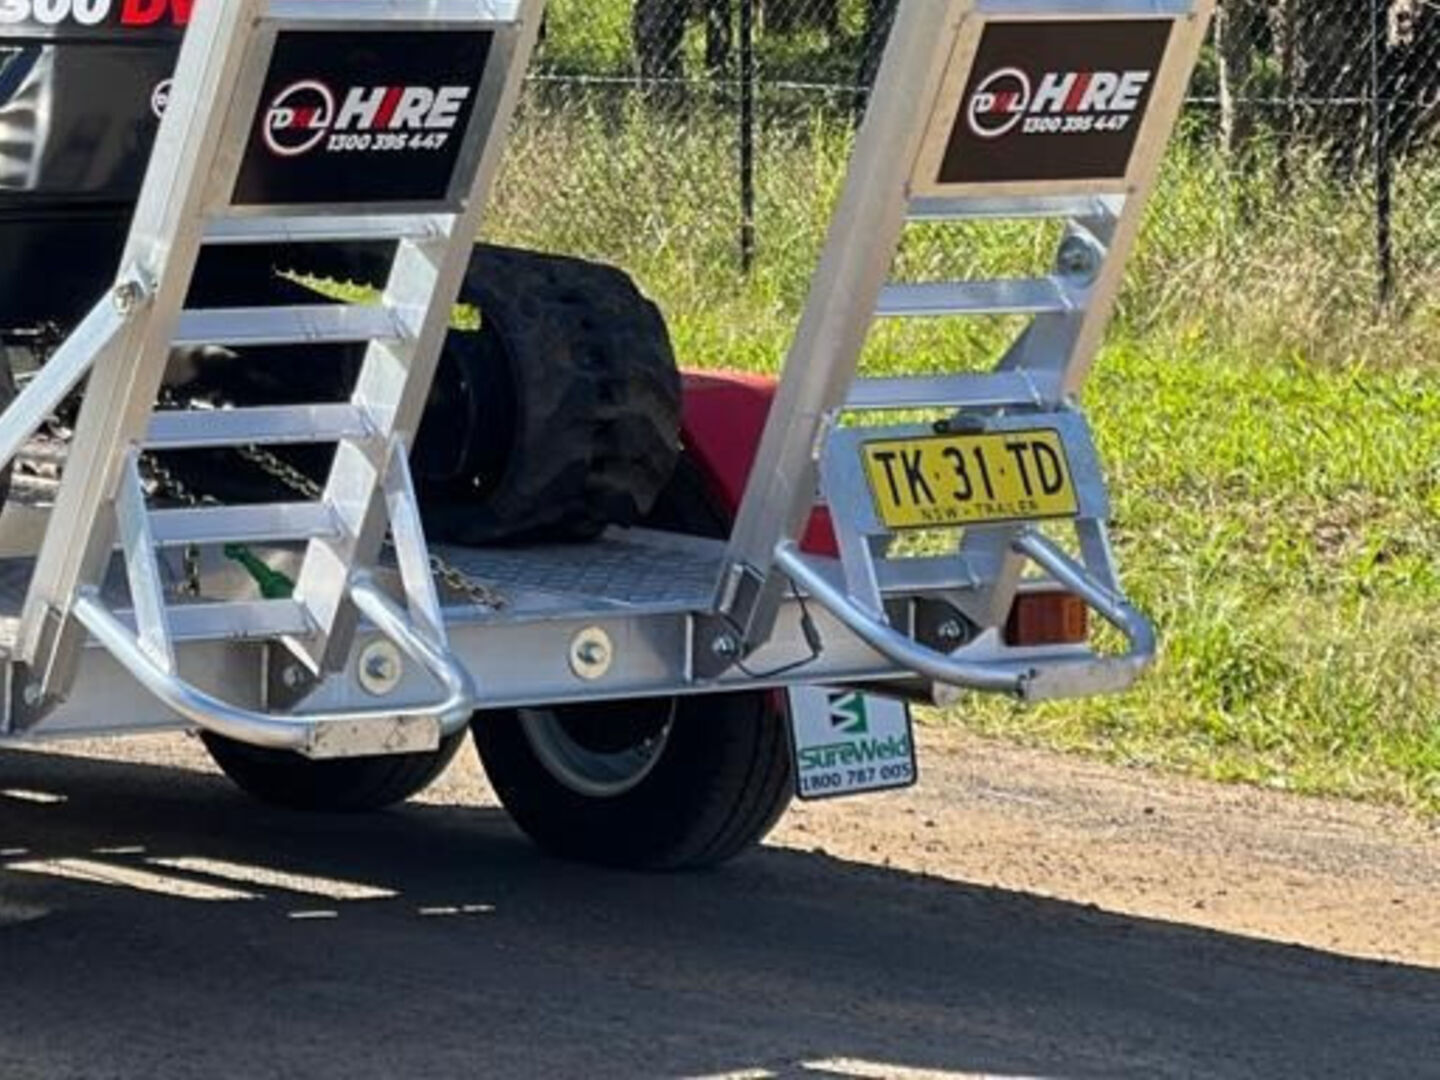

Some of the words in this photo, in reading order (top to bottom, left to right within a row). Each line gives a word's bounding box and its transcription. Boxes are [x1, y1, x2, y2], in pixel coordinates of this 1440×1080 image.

[334, 86, 470, 130] HIRE
[1029, 71, 1151, 113] HIRE
[327, 134, 372, 151] 1300
[799, 734, 910, 771] SureWeld
[803, 772, 842, 791] 1800
[846, 767, 876, 785] 787
[879, 762, 911, 781] 005
